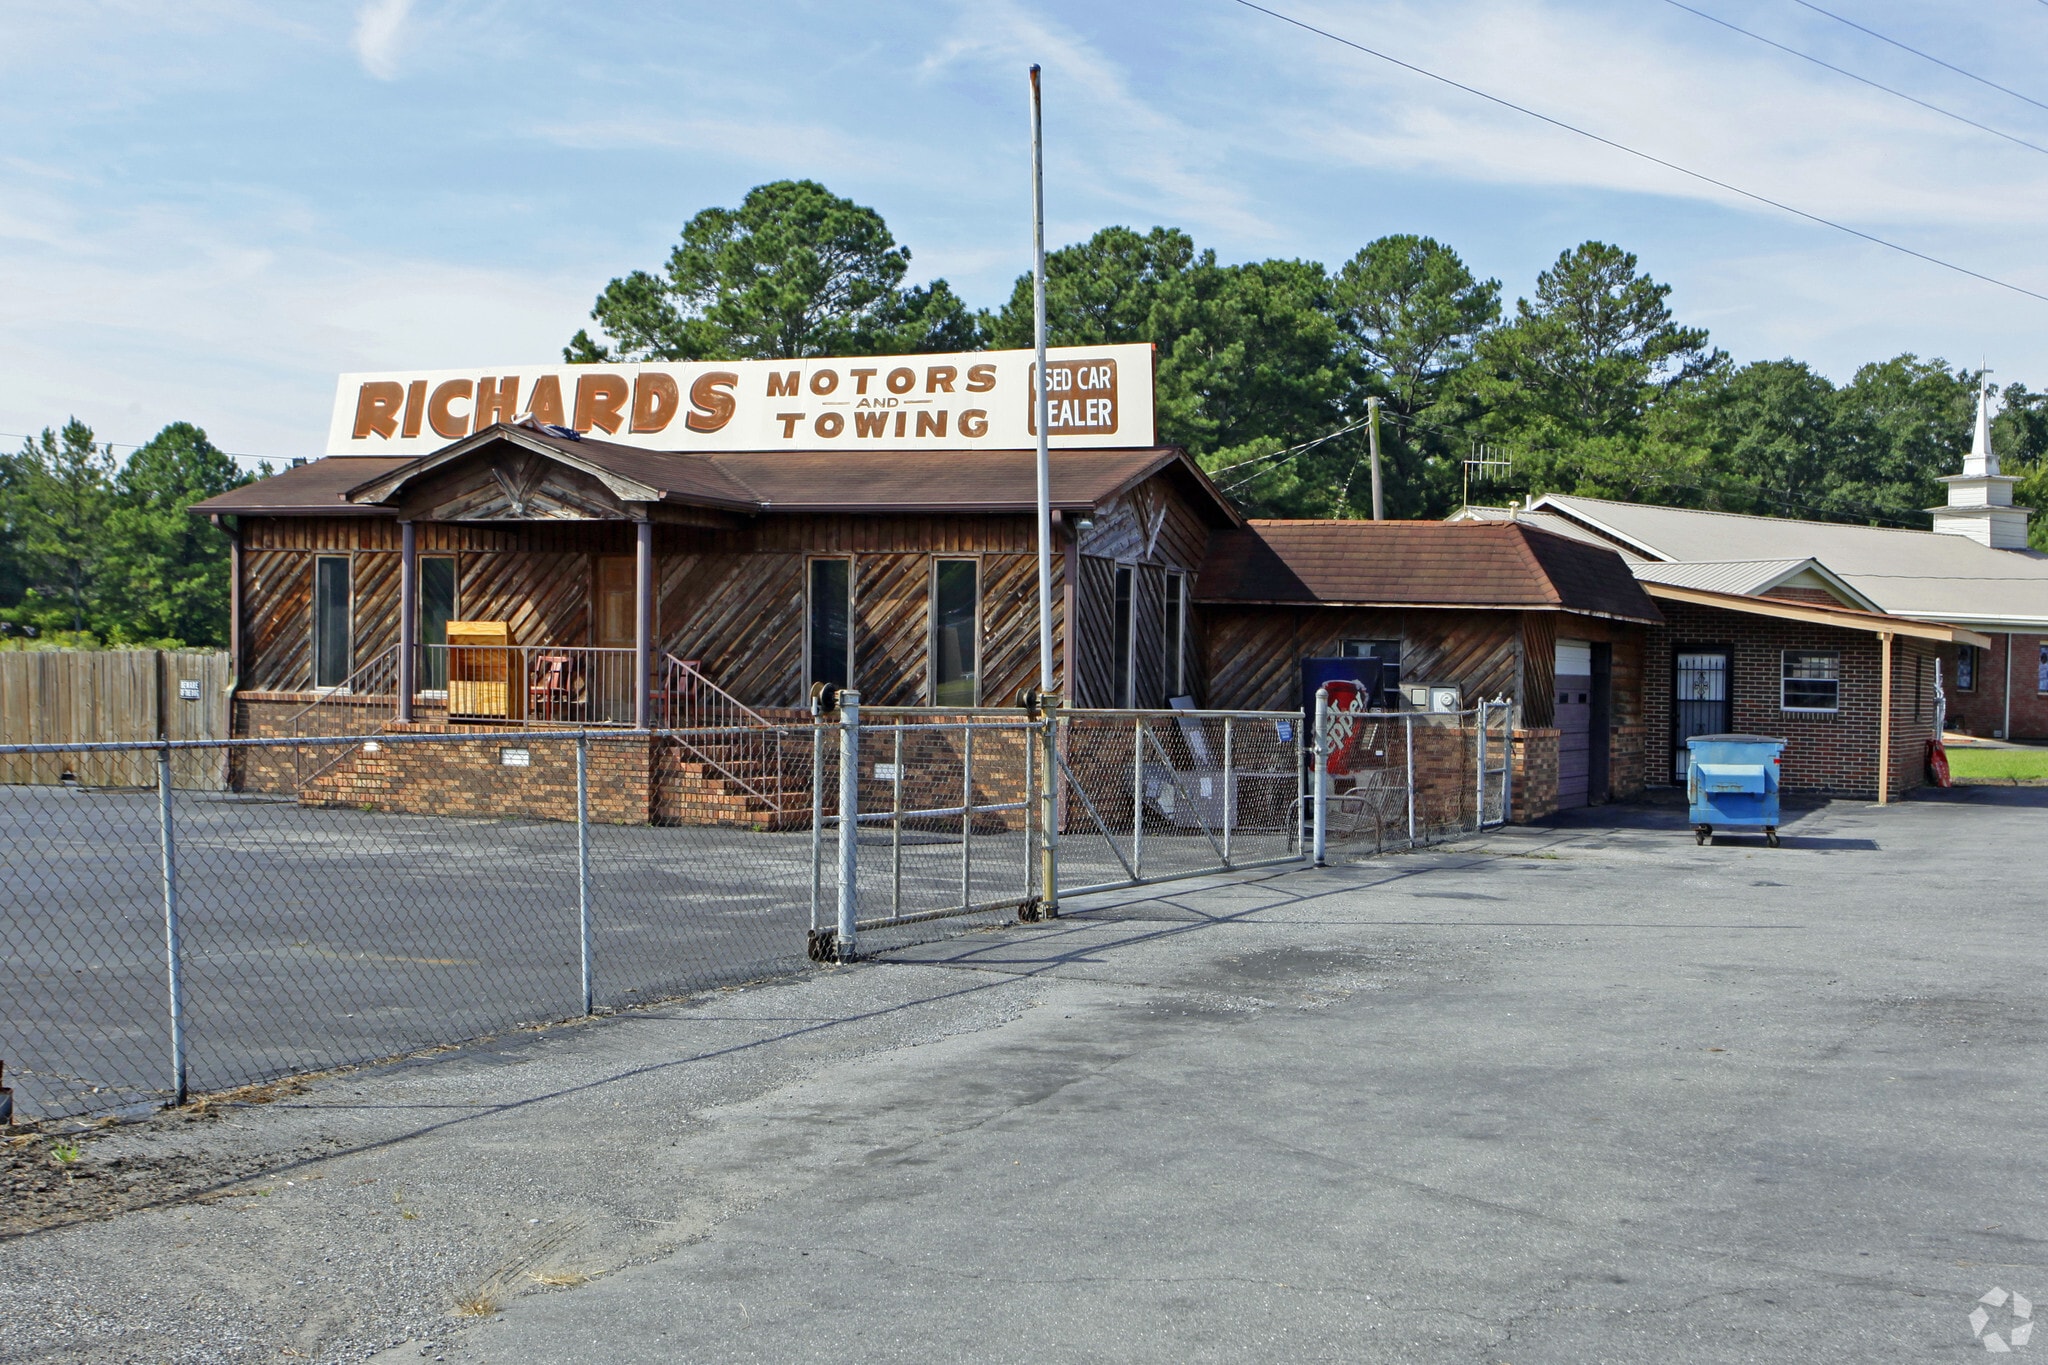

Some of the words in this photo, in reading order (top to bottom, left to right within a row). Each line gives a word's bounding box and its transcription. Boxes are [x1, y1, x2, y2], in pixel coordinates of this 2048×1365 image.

[766, 364, 997, 397] MOTORS
[1077, 366, 1111, 390] CAR
[352, 371, 739, 440] RICHARDS
[856, 397, 899, 409] AND
[1033, 398, 1112, 427] EALER
[776, 408, 989, 438] TOWING
